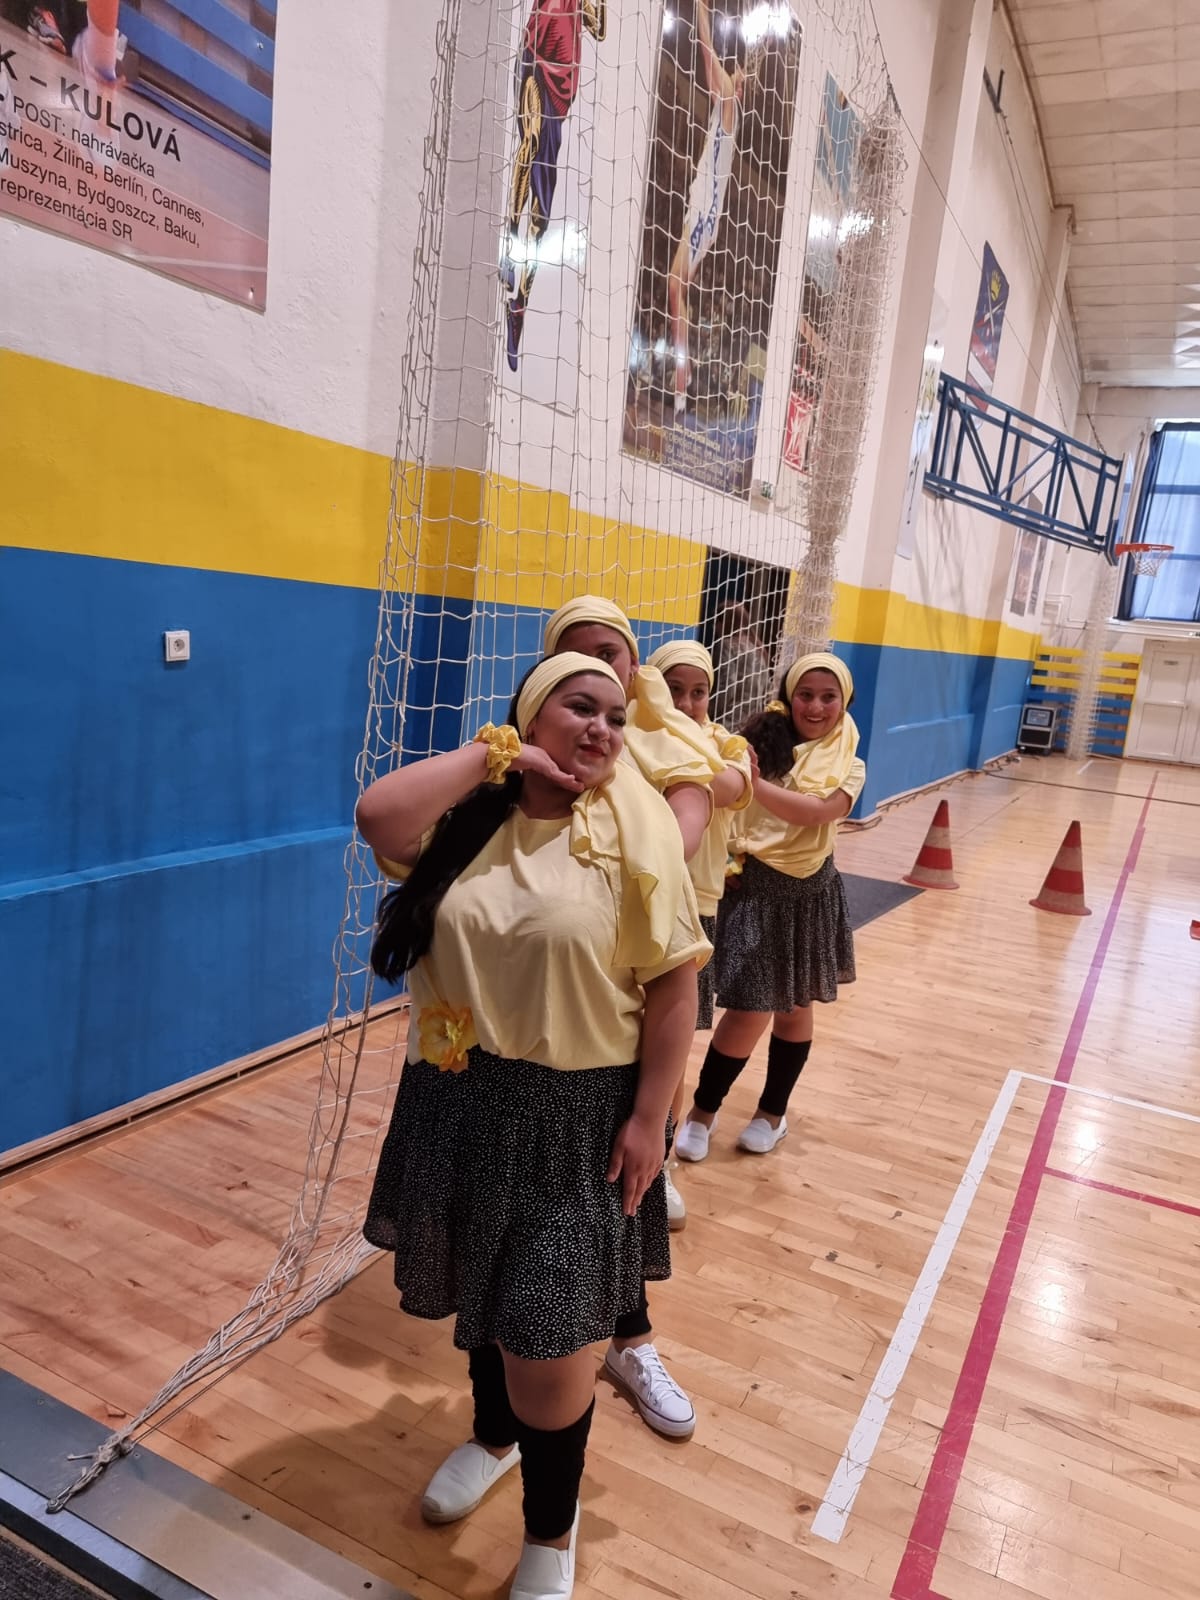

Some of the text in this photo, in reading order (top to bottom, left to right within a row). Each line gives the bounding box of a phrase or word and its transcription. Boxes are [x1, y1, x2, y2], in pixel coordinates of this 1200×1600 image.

[13, 95, 155, 178] POST: nahrávačka
[60, 76, 181, 162] KULOVÁ
[0, 120, 205, 228] strica, Žilina, Berlín, Cannes,
[0, 177, 133, 242] reprezentácia SR
[77, 178, 160, 232] Bydgoszcz,
[164, 216, 200, 249] Baku,
